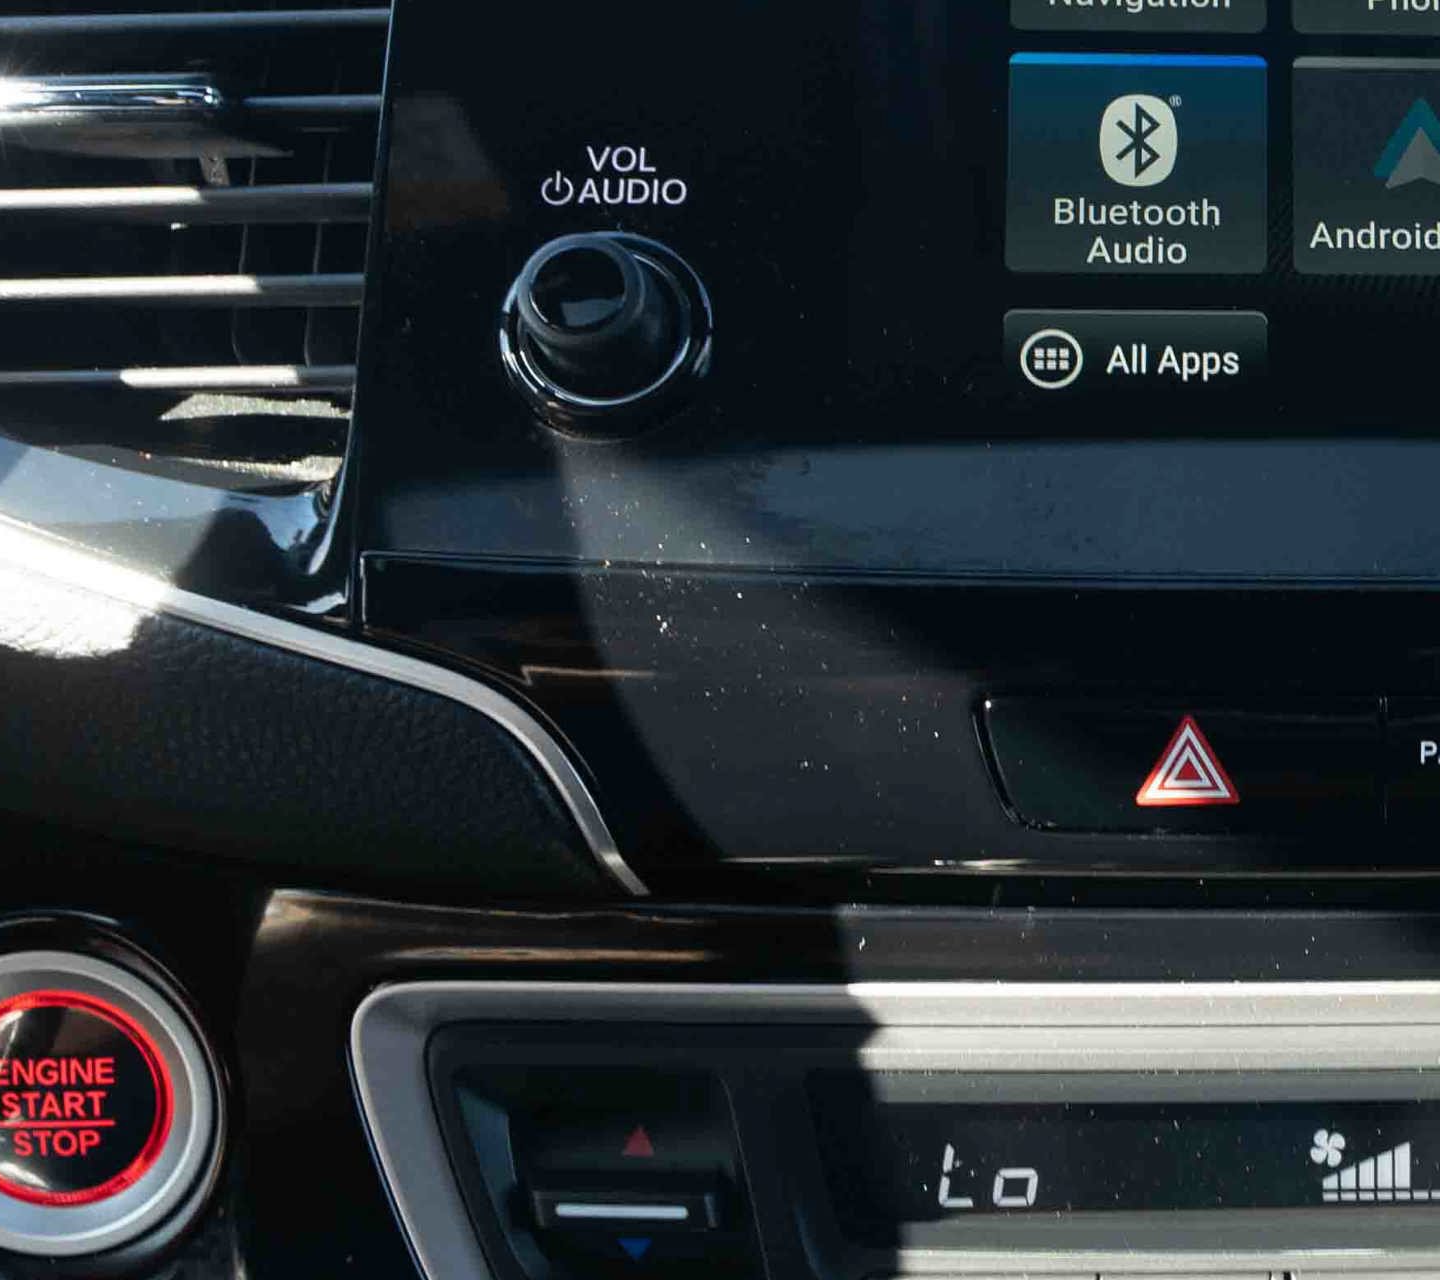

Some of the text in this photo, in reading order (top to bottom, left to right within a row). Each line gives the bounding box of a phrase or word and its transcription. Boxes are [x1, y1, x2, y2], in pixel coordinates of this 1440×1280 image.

[587, 147, 656, 172] VOL
[580, 178, 687, 204] AUDIO
[1053, 197, 1220, 227] Bluetooth
[1087, 236, 1187, 265] Audio
[1105, 345, 1240, 380] All Apps
[1, 1091, 108, 1118] START
[14, 1130, 100, 1157] STOP
